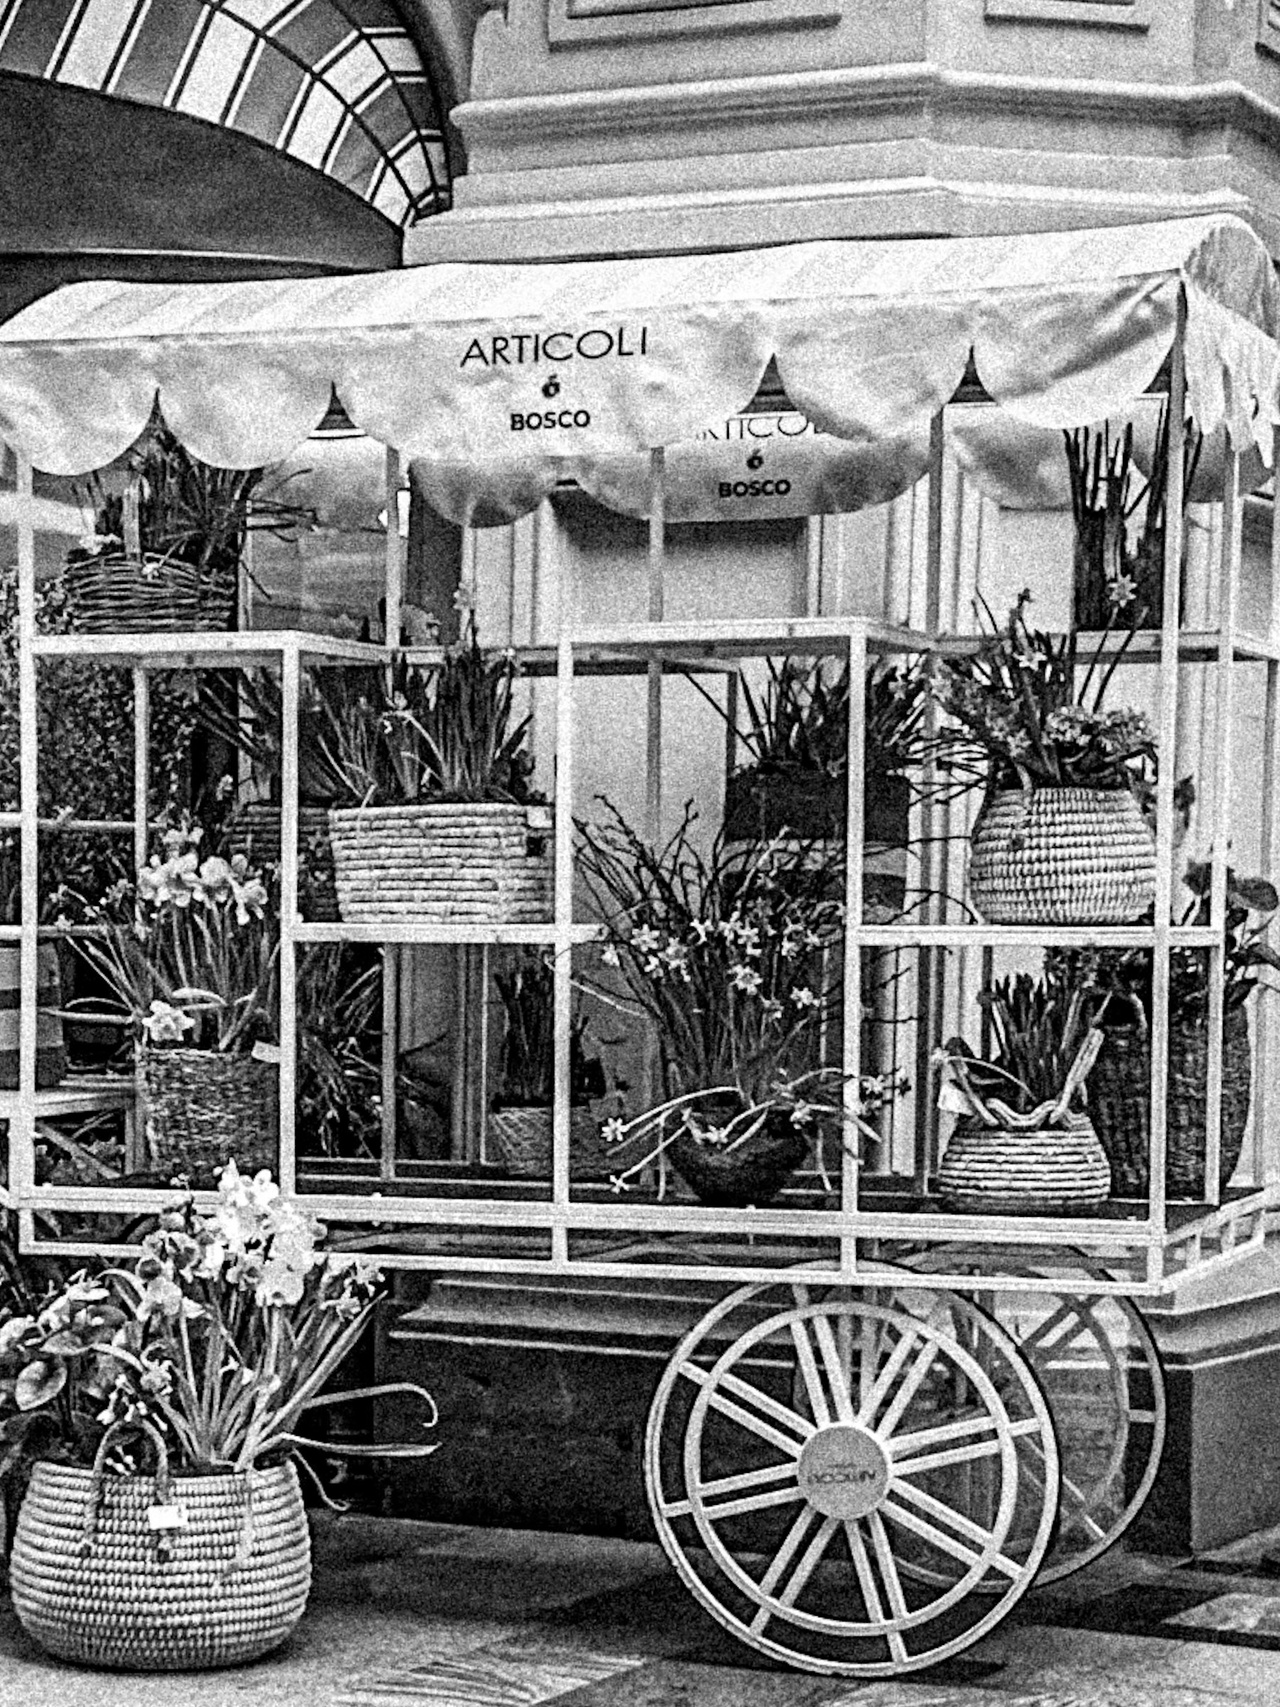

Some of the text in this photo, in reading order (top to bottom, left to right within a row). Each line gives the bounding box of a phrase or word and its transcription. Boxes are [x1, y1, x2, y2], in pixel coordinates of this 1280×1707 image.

[459, 326, 648, 368] ARTICOLI
[510, 410, 591, 431] BOSCO
[718, 479, 792, 498] BOSCO
